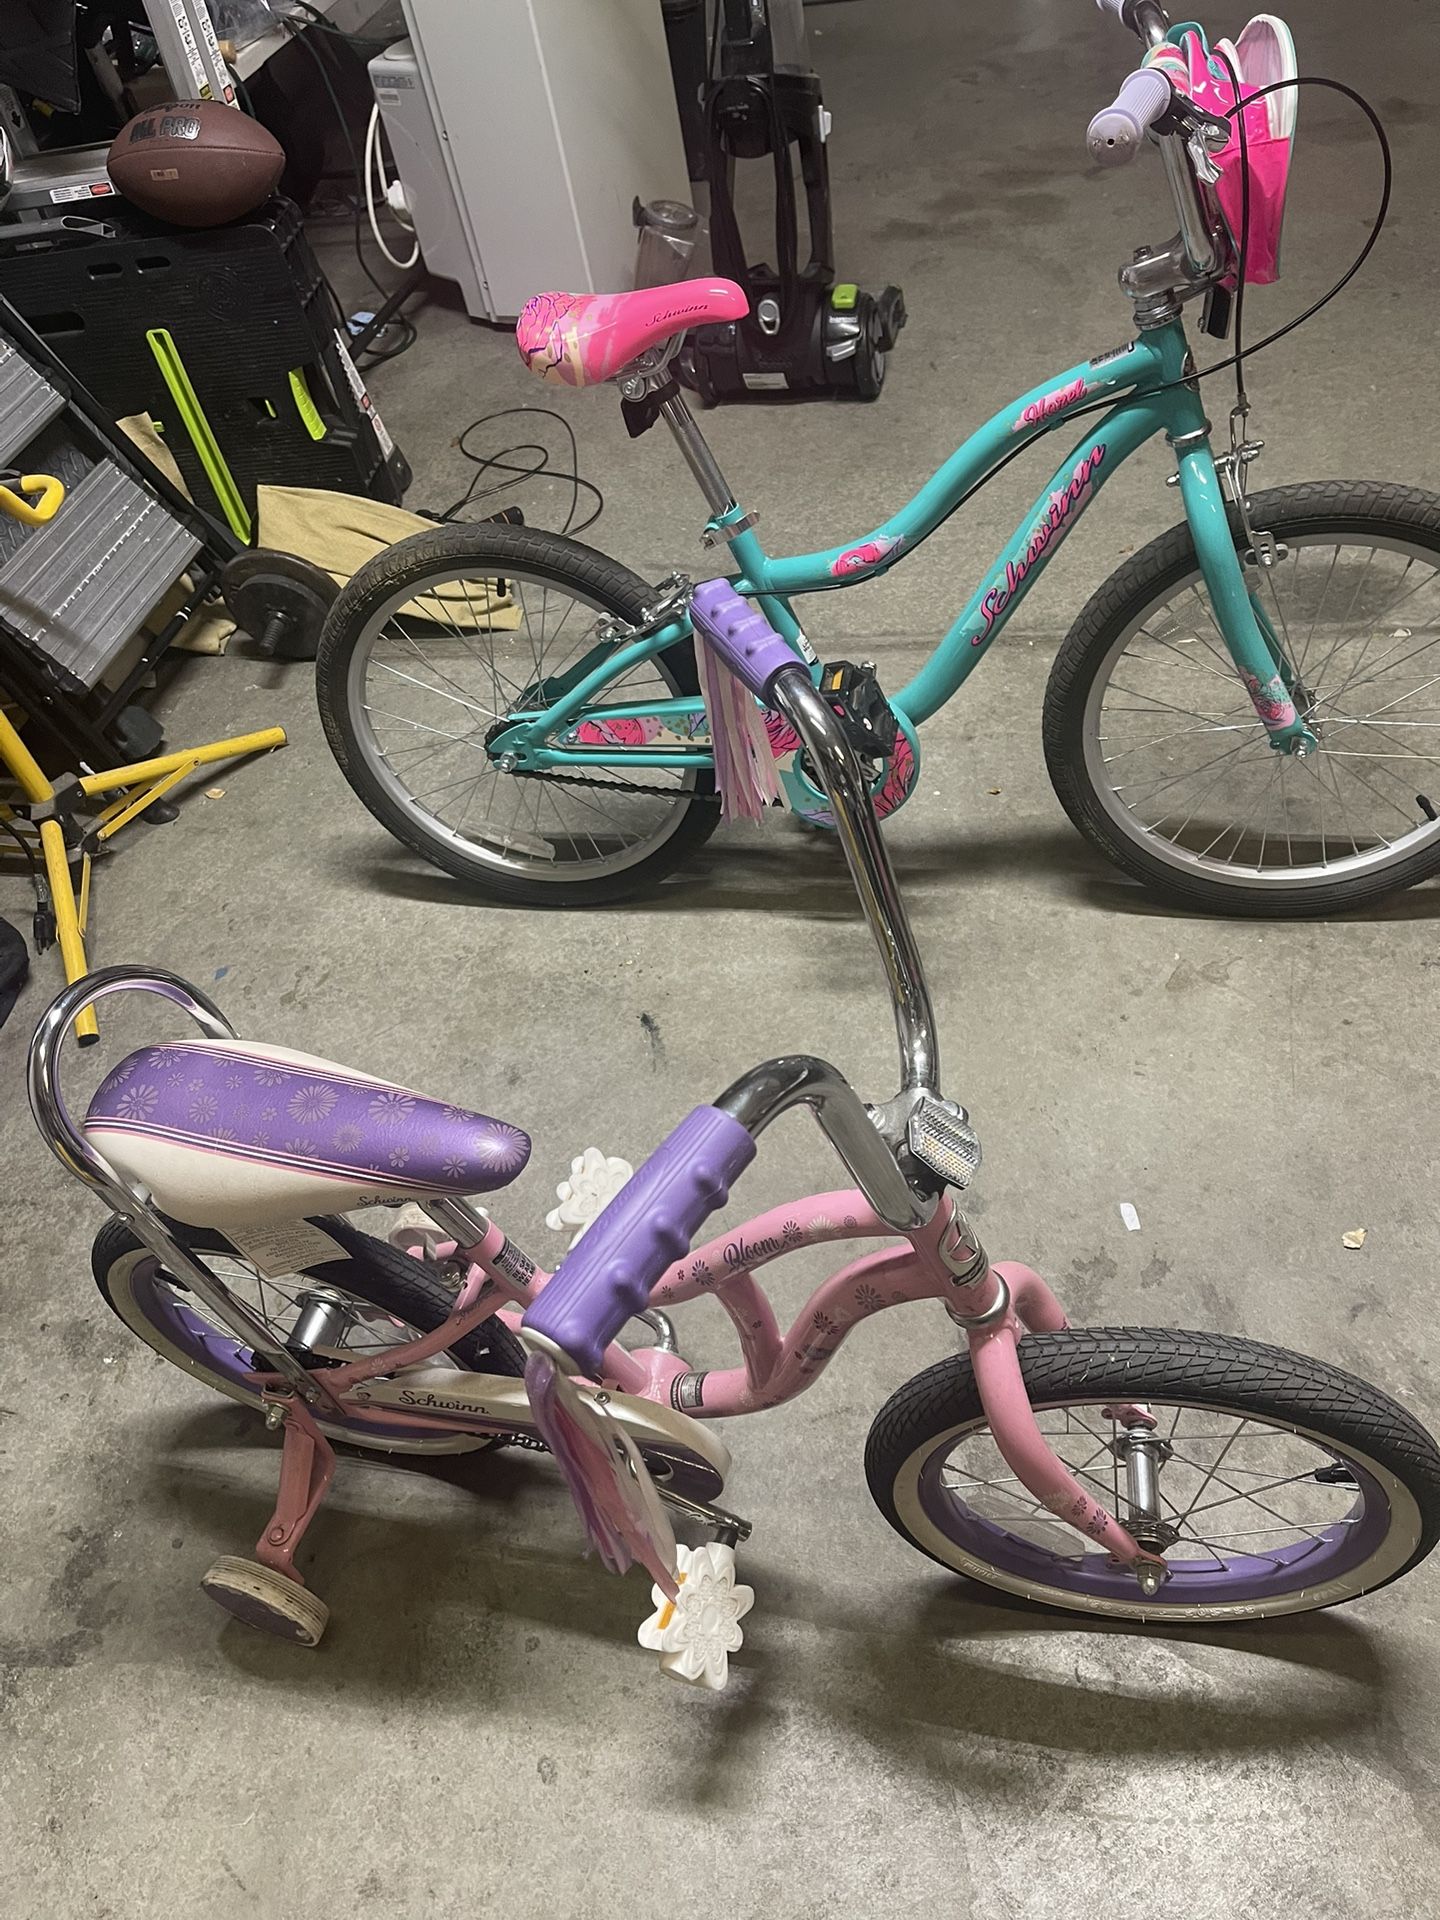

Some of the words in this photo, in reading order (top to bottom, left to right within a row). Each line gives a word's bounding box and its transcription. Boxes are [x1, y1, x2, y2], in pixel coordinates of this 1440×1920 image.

[160, 115, 200, 140] PRO
[645, 304, 709, 327] Schwinn
[971, 443, 1107, 647] Schwinn
[356, 1195, 412, 1206] Schwinn
[723, 1237, 784, 1273] Bloom
[399, 1390, 491, 1415] Schwinn
